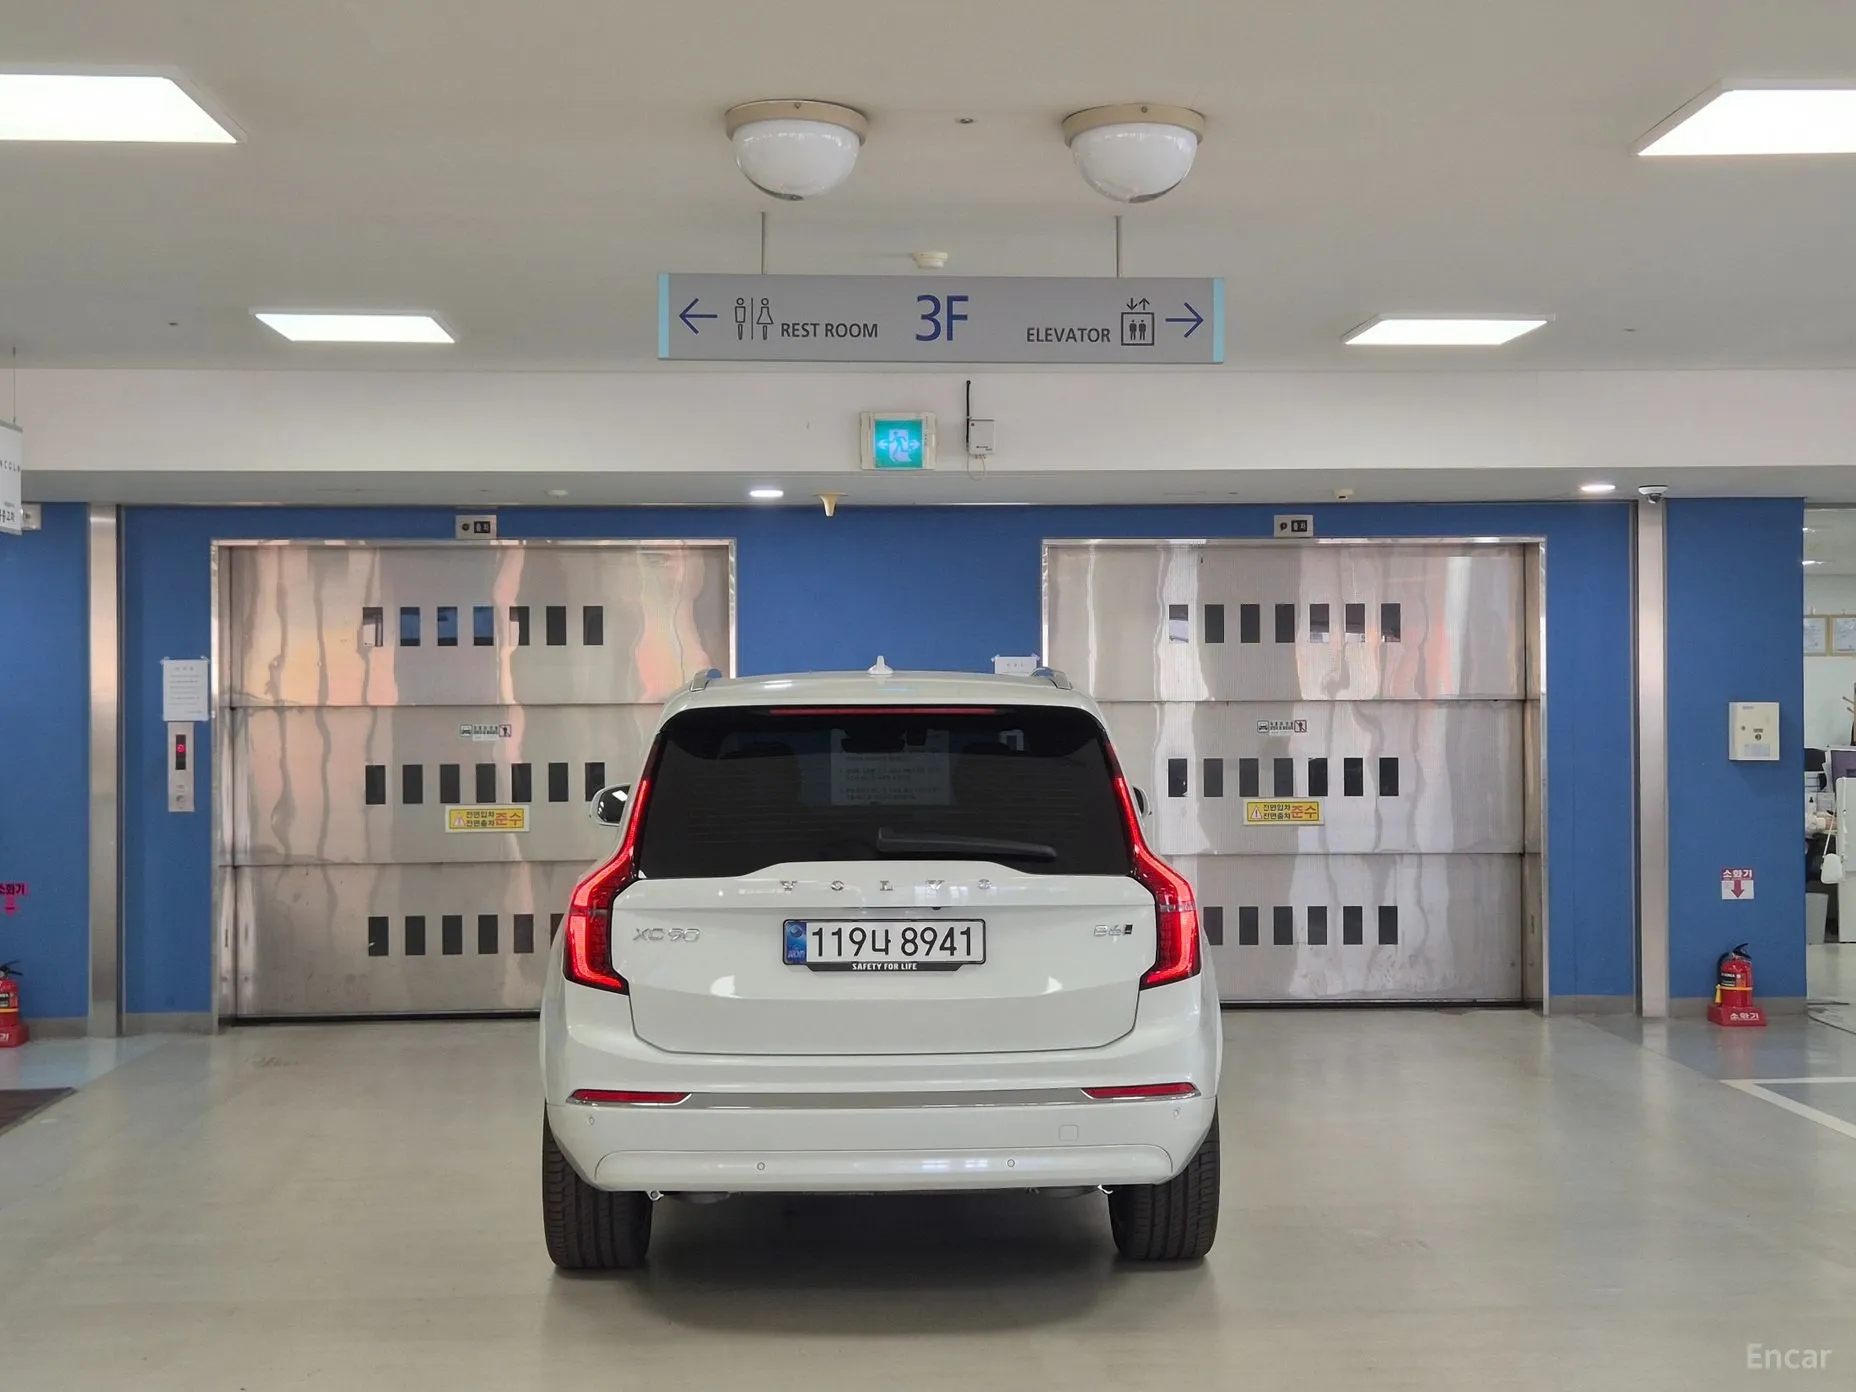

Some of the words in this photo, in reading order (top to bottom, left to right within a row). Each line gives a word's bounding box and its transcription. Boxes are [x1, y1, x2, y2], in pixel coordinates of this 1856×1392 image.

[915, 294, 969, 342] 3F
[781, 322, 820, 338] REST
[825, 322, 878, 338] ROOM
[1026, 327, 1111, 343] ELEVATOR
[1722, 869, 1752, 879] 소화기
[779, 878, 993, 891] VOLVO
[812, 926, 891, 957] 119나
[900, 926, 972, 957] 8941
[852, 962, 882, 971] SAFETY
[883, 962, 899, 971] FOR
[900, 962, 918, 971] LIFE
[1730, 1012, 1760, 1021] 소화기
